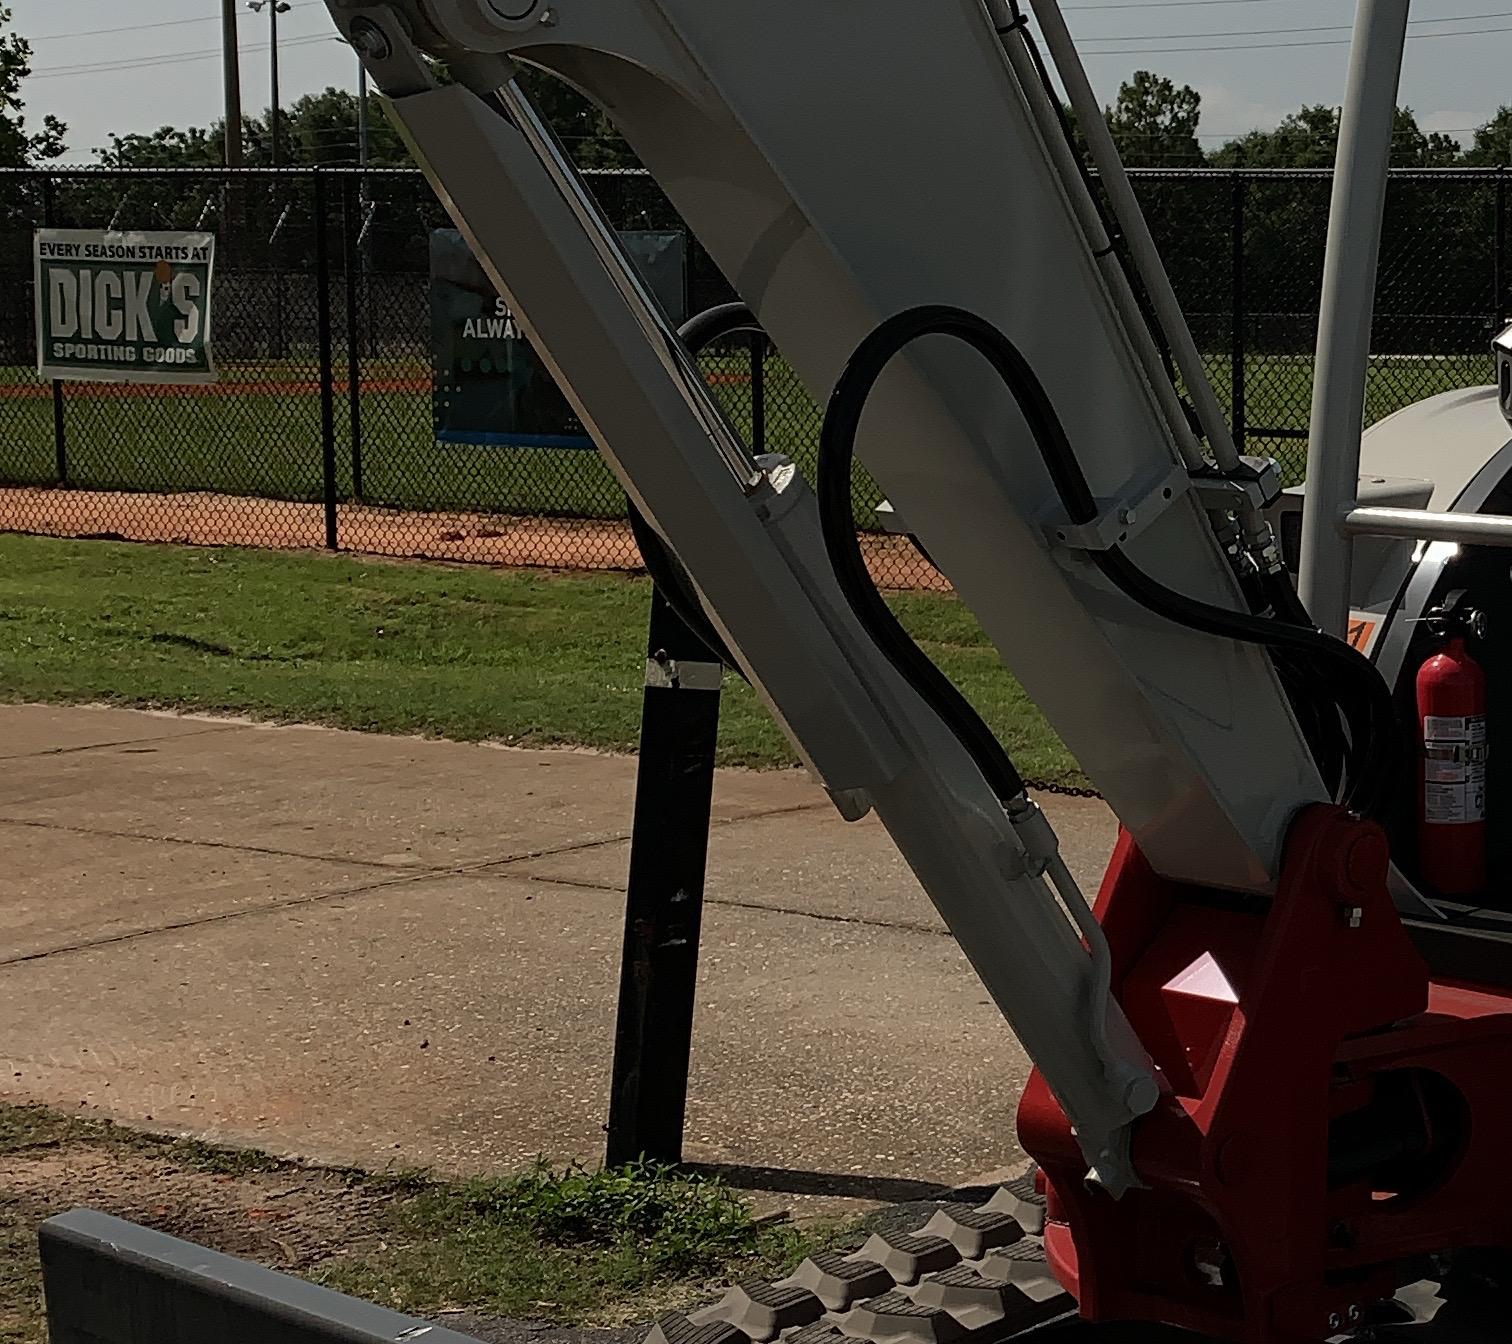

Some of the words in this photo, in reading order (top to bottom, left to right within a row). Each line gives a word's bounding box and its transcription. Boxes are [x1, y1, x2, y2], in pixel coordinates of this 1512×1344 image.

[40, 242, 80, 256] EVERY
[85, 244, 135, 259] SEASON
[139, 246, 189, 260] STARTS
[192, 247, 208, 261] AT
[48, 267, 201, 344] DICK'S
[462, 317, 523, 340] ALWAY
[53, 343, 136, 362] SPORTING
[143, 347, 198, 364] GOODS
